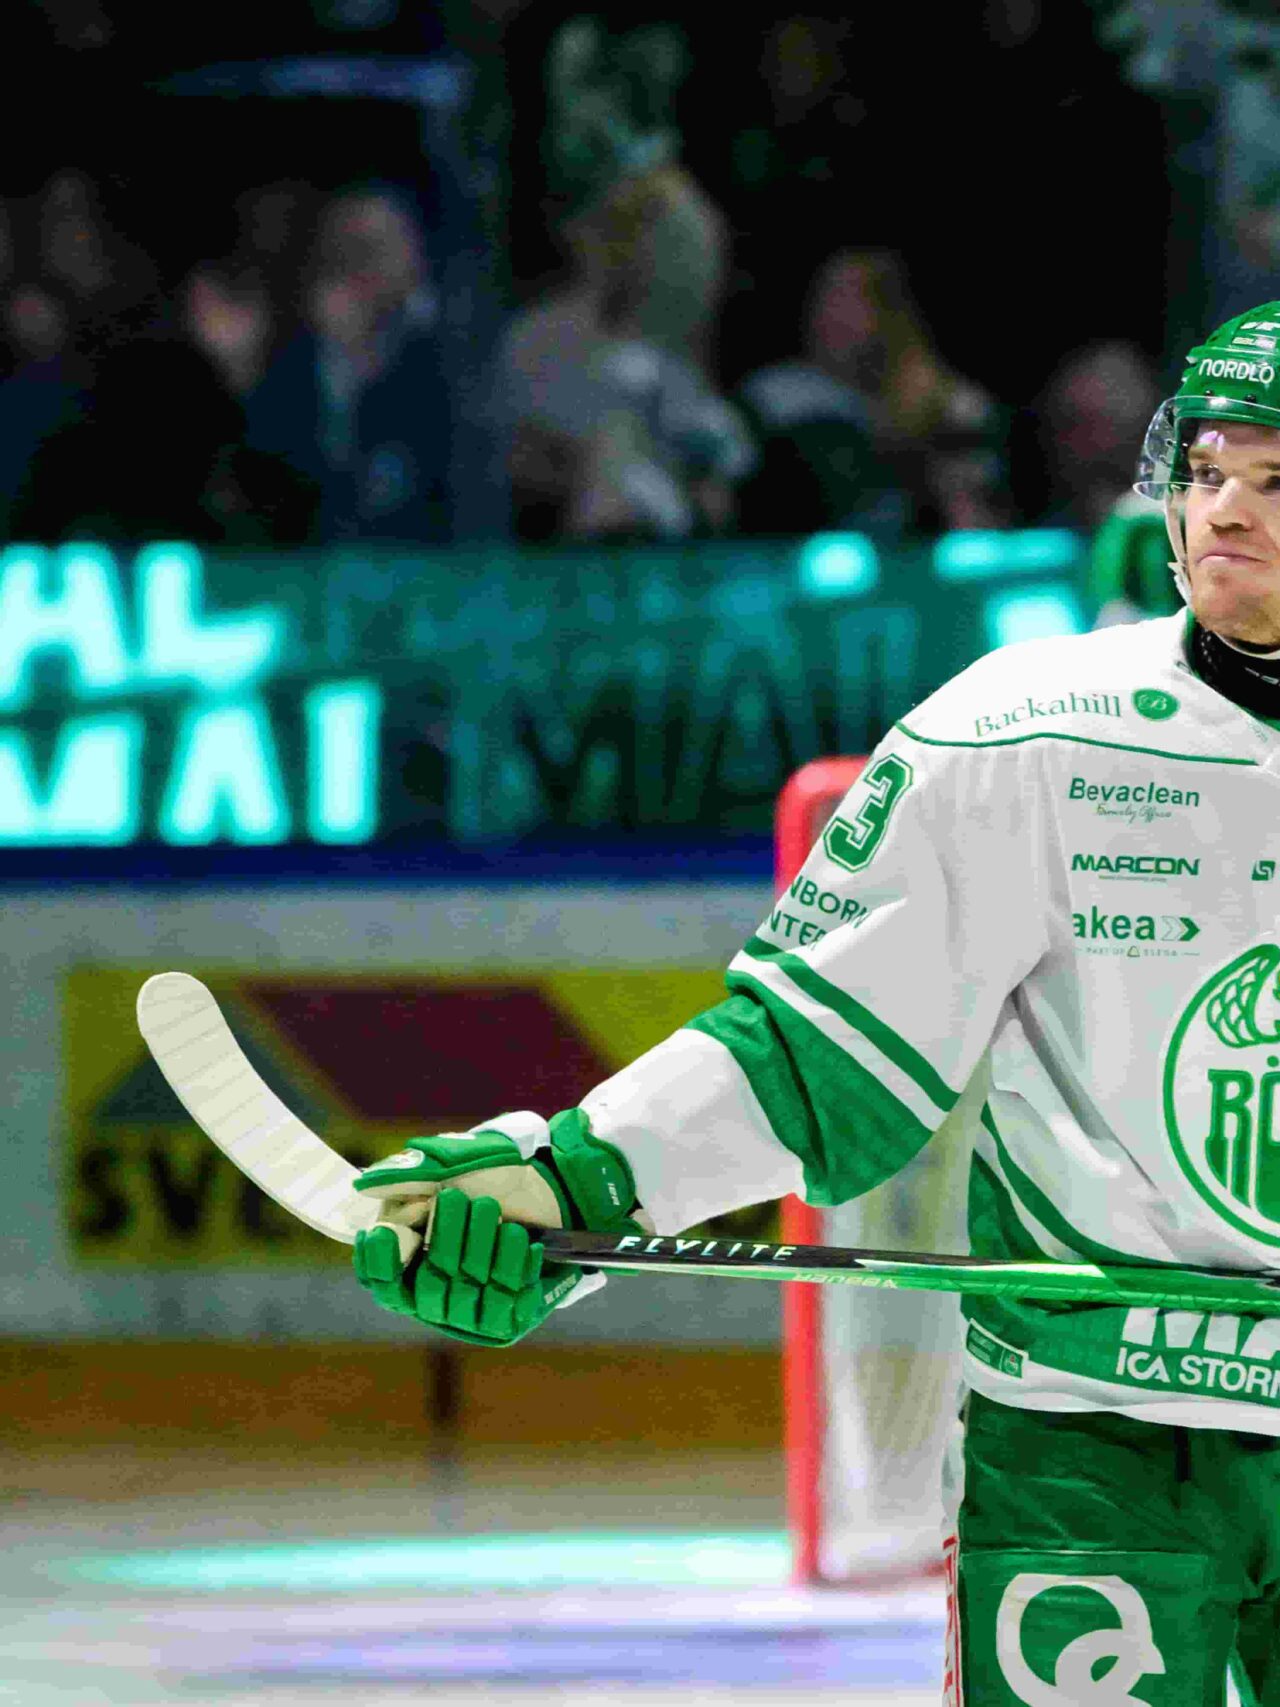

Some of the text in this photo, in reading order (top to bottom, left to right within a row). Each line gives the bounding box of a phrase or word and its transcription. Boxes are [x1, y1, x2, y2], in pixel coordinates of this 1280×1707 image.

[974, 692, 1121, 737] Backahill
[1068, 777, 1200, 807] Bevaclean
[823, 753, 914, 873] 3
[1071, 854, 1200, 876] MARCON
[613, 1235, 798, 1261] FLYLITE
[1116, 1347, 1170, 1382] ICA
